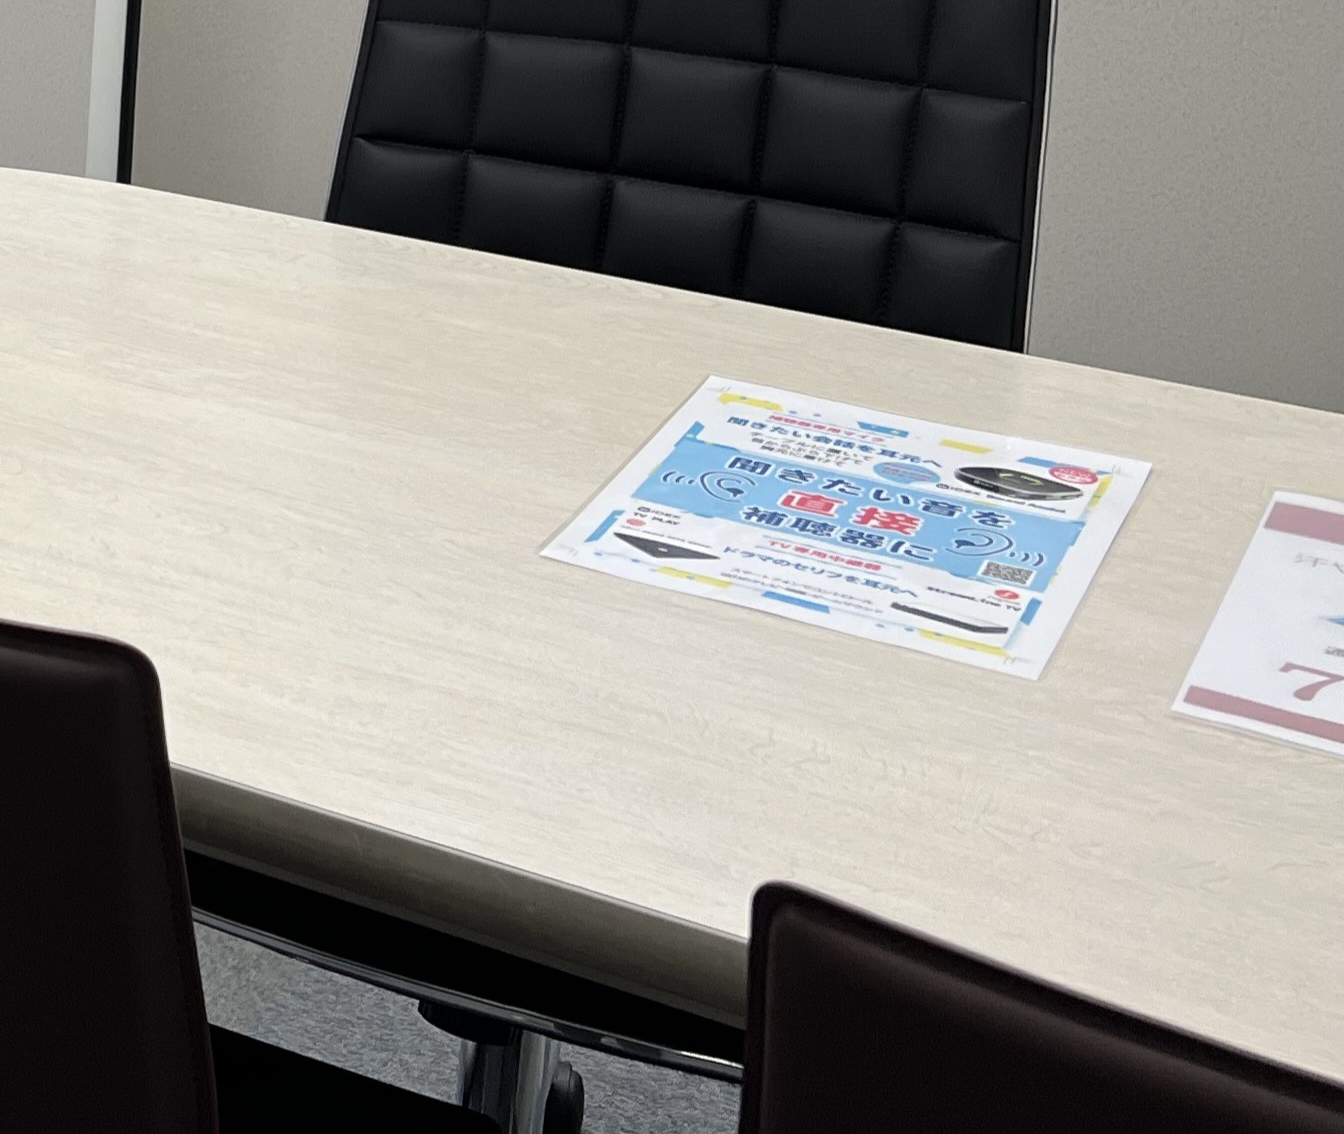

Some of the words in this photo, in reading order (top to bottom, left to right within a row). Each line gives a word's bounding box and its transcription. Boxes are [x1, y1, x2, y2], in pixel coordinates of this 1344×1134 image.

[727, 415, 943, 468] 聞きたい会話を耳元へ
[728, 455, 1016, 530] 聞きたい音を
[778, 489, 926, 538] 直接
[740, 504, 941, 562] 補聴器に
